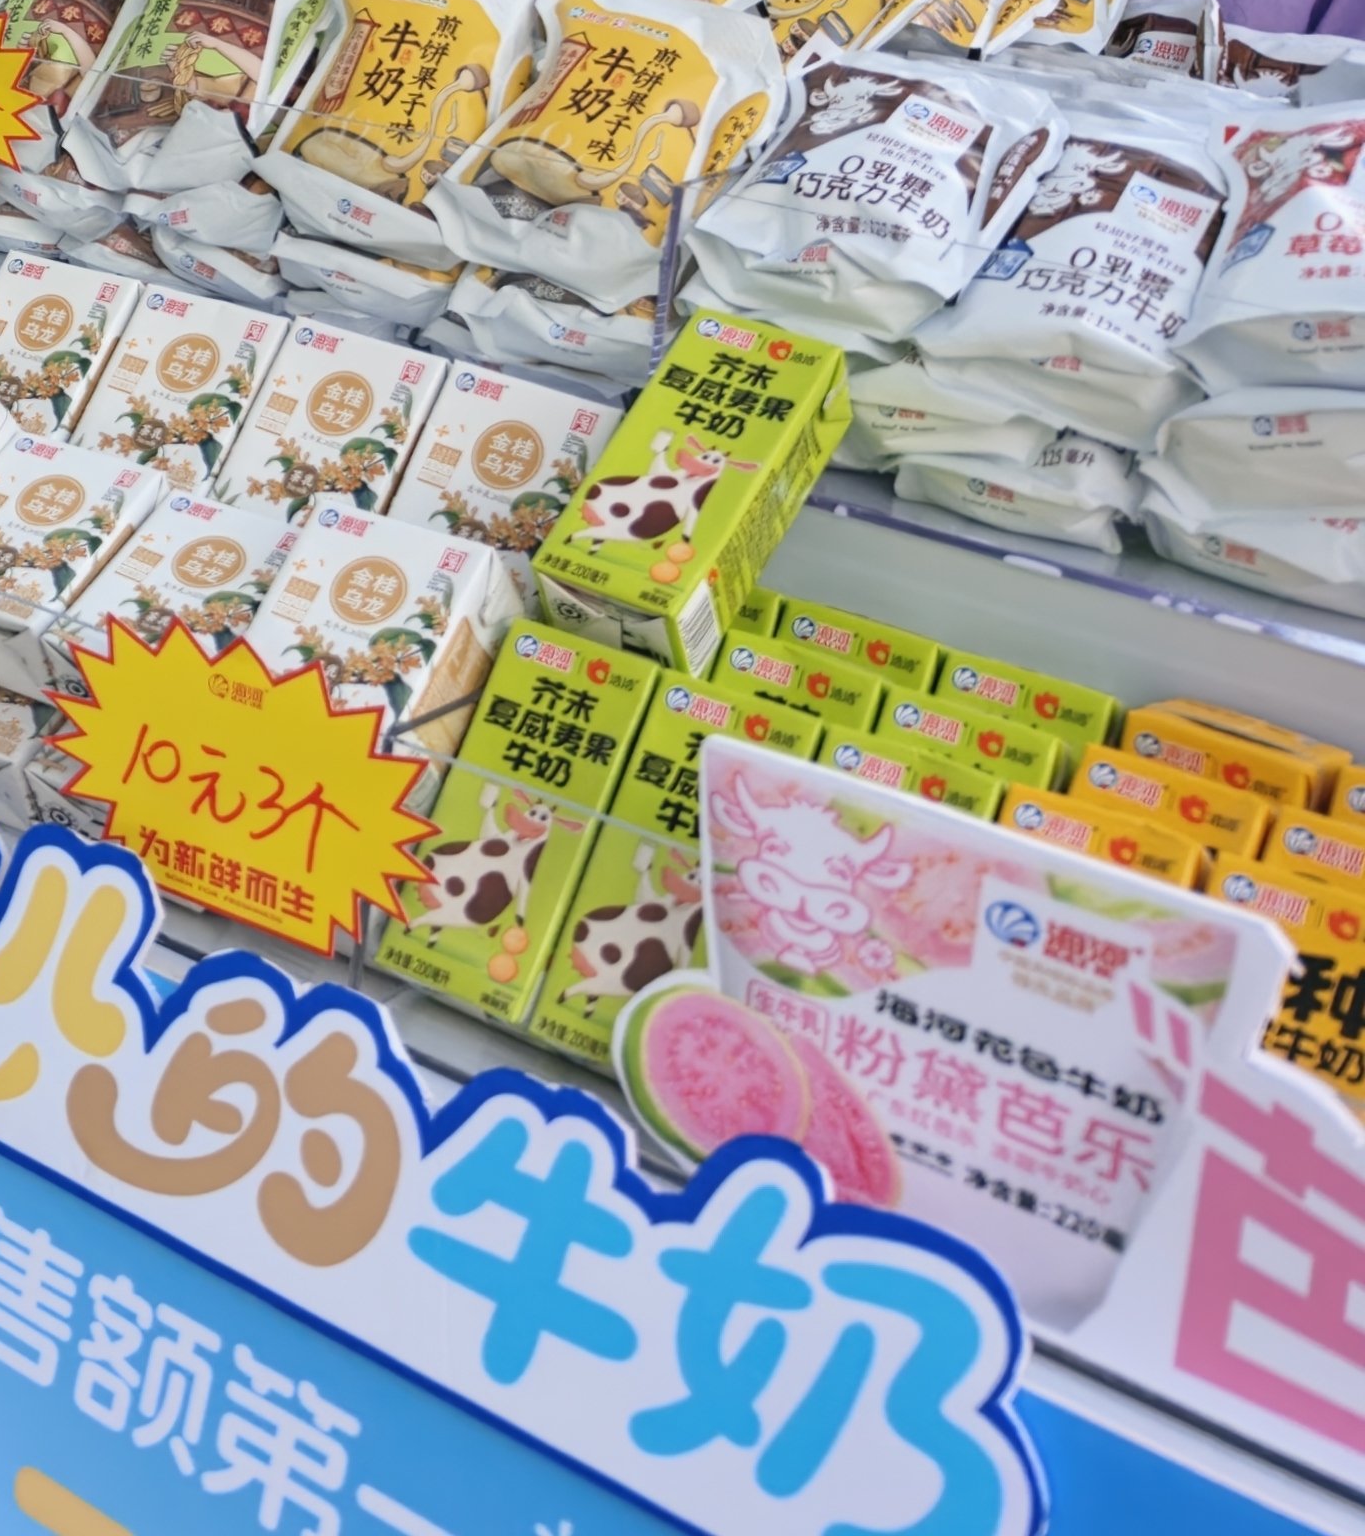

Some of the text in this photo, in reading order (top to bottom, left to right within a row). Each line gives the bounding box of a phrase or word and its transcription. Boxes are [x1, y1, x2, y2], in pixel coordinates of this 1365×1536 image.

[356, 19, 422, 107] 牛奶
[385, 14, 464, 146] 煎饼果子味
[558, 46, 637, 124] 牛奶
[586, 45, 683, 163] 煎饼果子味
[793, 170, 952, 240] 巧克力牛奶
[31, 304, 66, 327] 金桂
[1017, 266, 1190, 340] 巧克力牛奶
[21, 321, 56, 344] 乌龙
[163, 363, 203, 385] 乌龙
[173, 342, 213, 367] 金桂
[707, 350, 779, 391] 芥末
[323, 380, 365, 407] 金桂
[657, 363, 796, 423] 夏威夷果
[314, 402, 356, 429] 乌龙
[674, 400, 746, 441] 牛奶
[489, 429, 535, 461] 金桂
[479, 454, 525, 483] 乌龙
[23, 499, 65, 522] 乌龙
[37, 482, 77, 507] 金桂
[178, 560, 224, 584] 乌龙
[192, 543, 238, 568] 金桂
[350, 566, 400, 597] 金桂
[337, 588, 387, 619] 乌龙
[531, 676, 600, 724] 芥末
[483, 694, 618, 767] 夏威夷果
[501, 738, 573, 789] 牛奶
[121, 723, 361, 874] 10元3个
[138, 824, 316, 925] 为新鲜而生
[874, 988, 1165, 1126] 海河花色牛奶
[834, 1013, 1158, 1194] 粉黛芭乐
